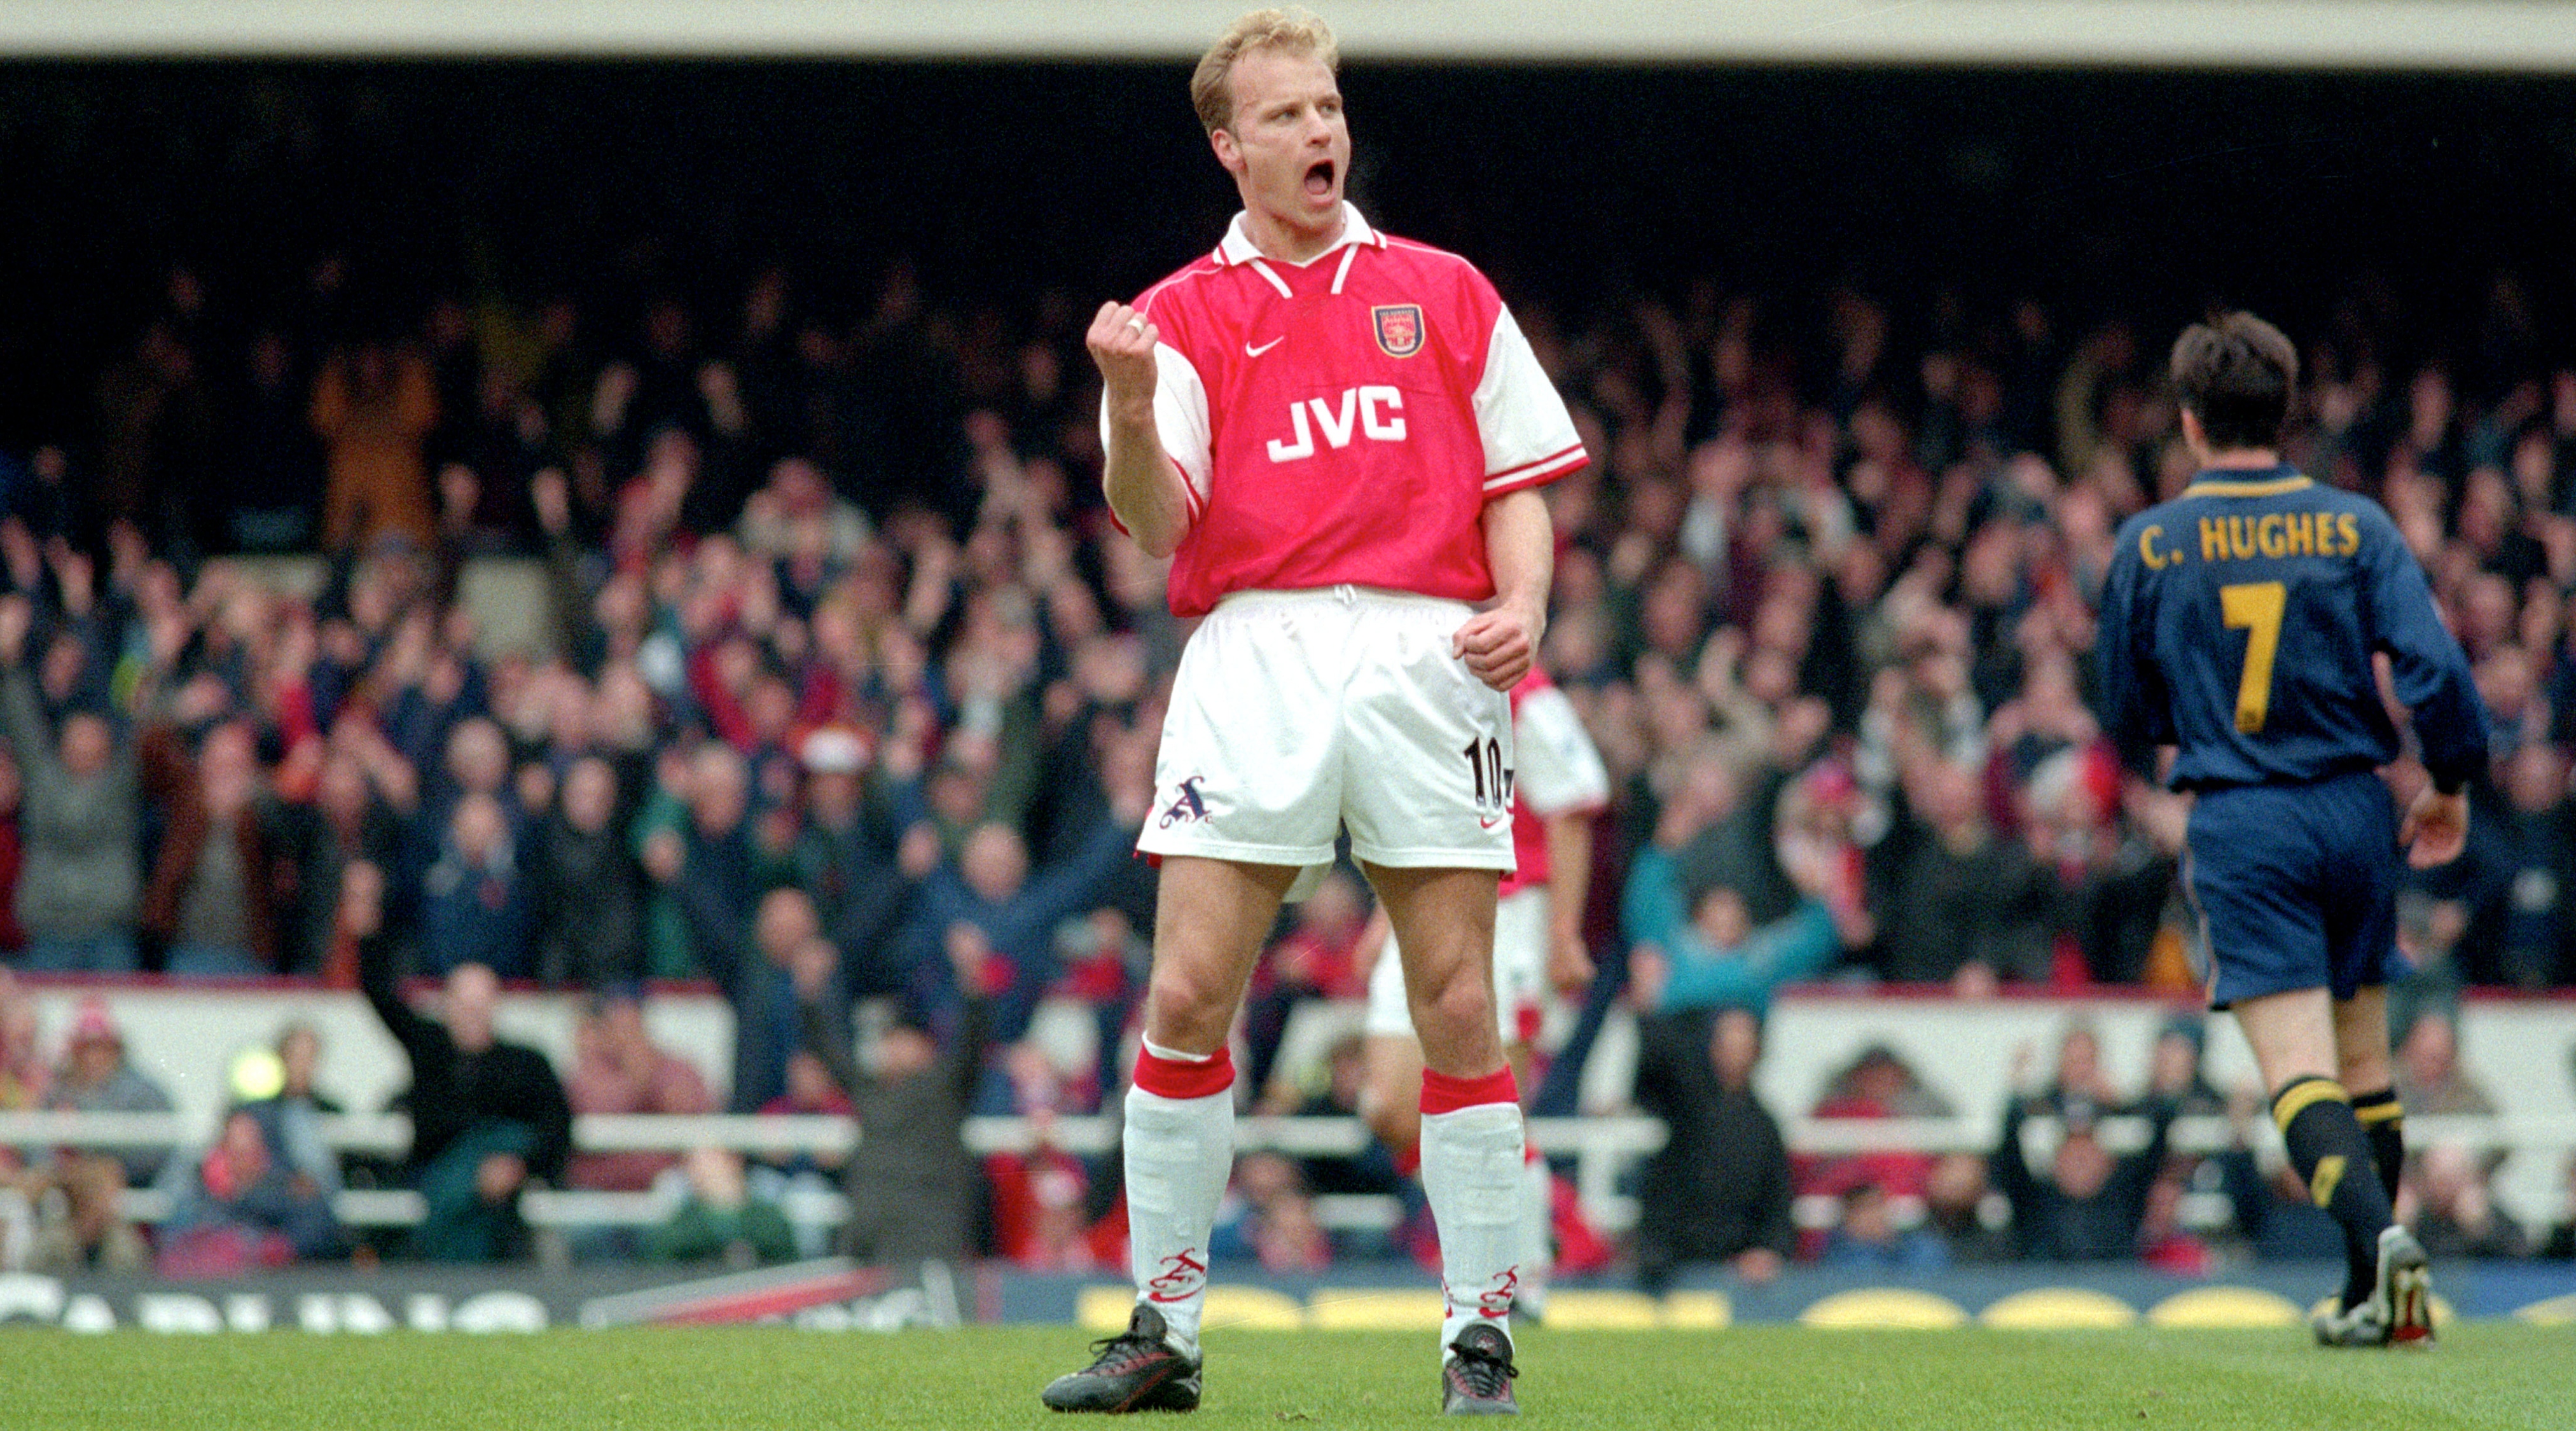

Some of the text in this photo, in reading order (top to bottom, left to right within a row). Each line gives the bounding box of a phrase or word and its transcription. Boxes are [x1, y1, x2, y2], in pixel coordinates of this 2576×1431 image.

[1266, 385, 1406, 463] JVC
[2139, 513, 2360, 569] C. HUGHES
[2220, 581, 2286, 733] 7
[1464, 736, 1502, 808] 10
